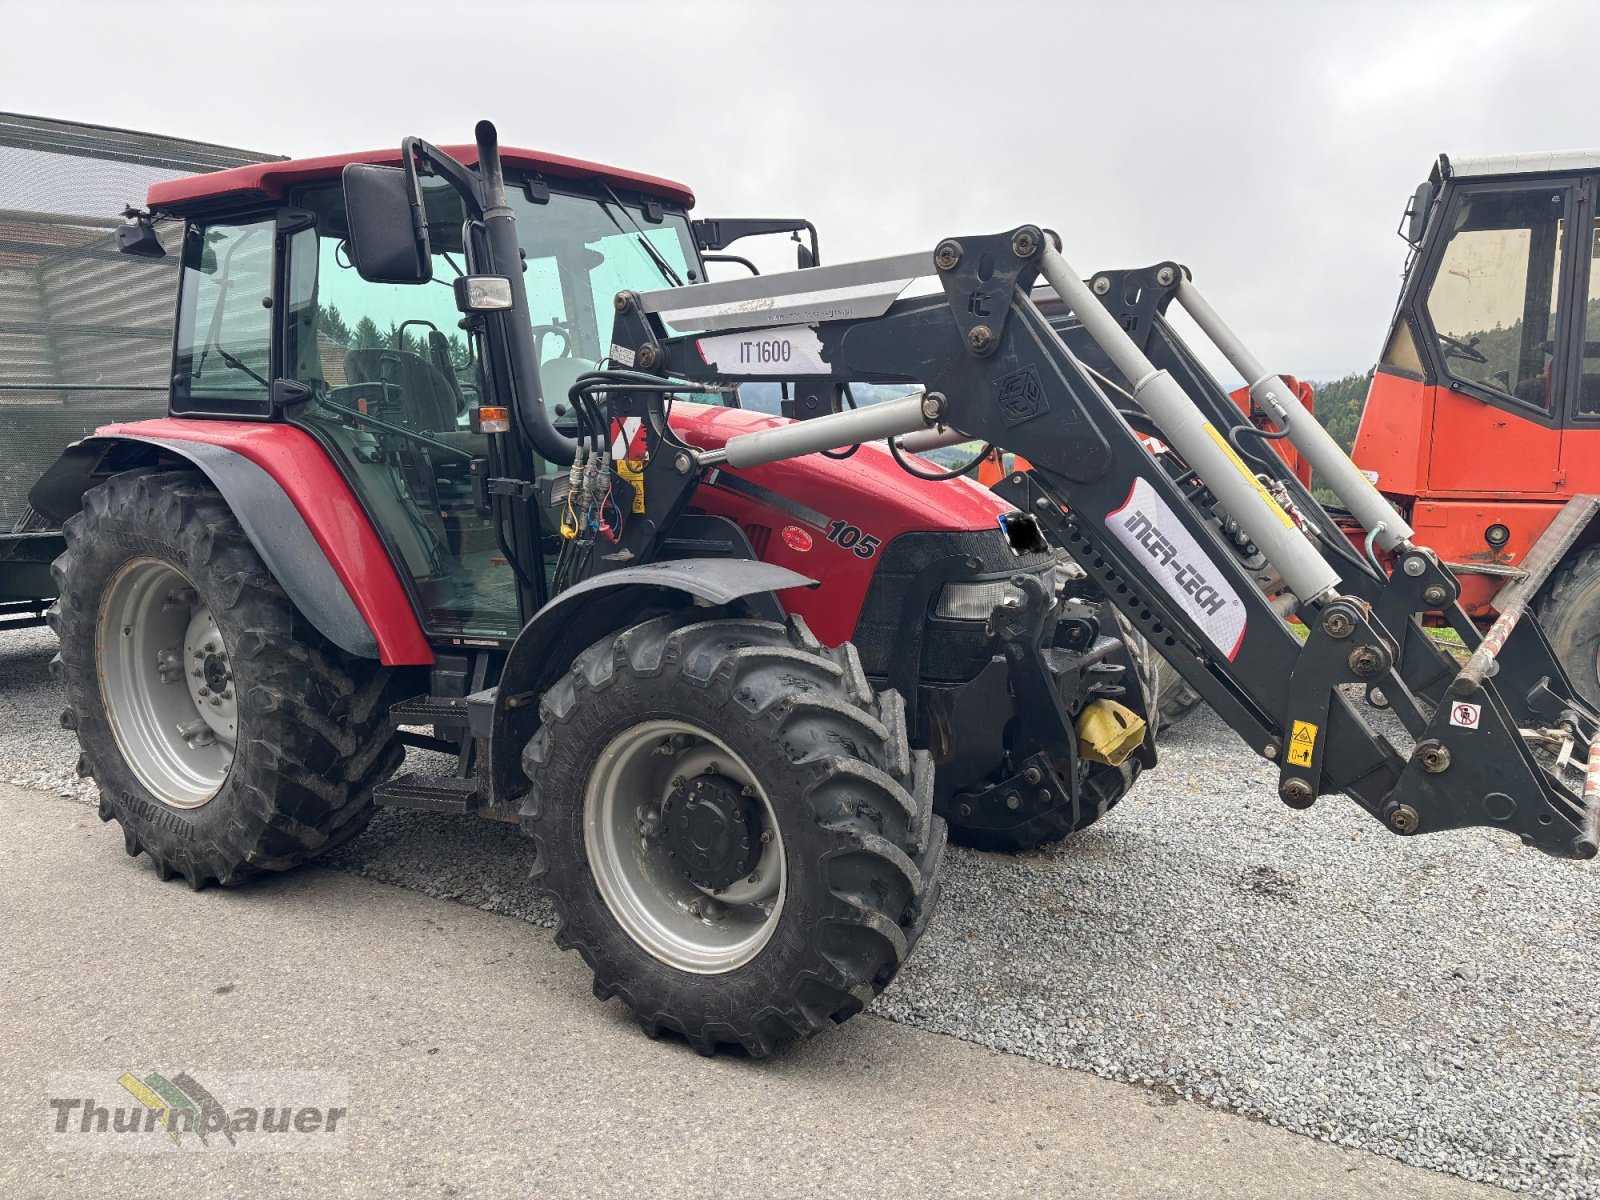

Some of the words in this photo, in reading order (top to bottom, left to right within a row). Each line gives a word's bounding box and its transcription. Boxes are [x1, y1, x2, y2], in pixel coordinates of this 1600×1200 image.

[740, 341, 752, 363] IT
[755, 340, 791, 363] 1600
[826, 518, 882, 560] 105
[119, 791, 196, 842] TRELLEBORG
